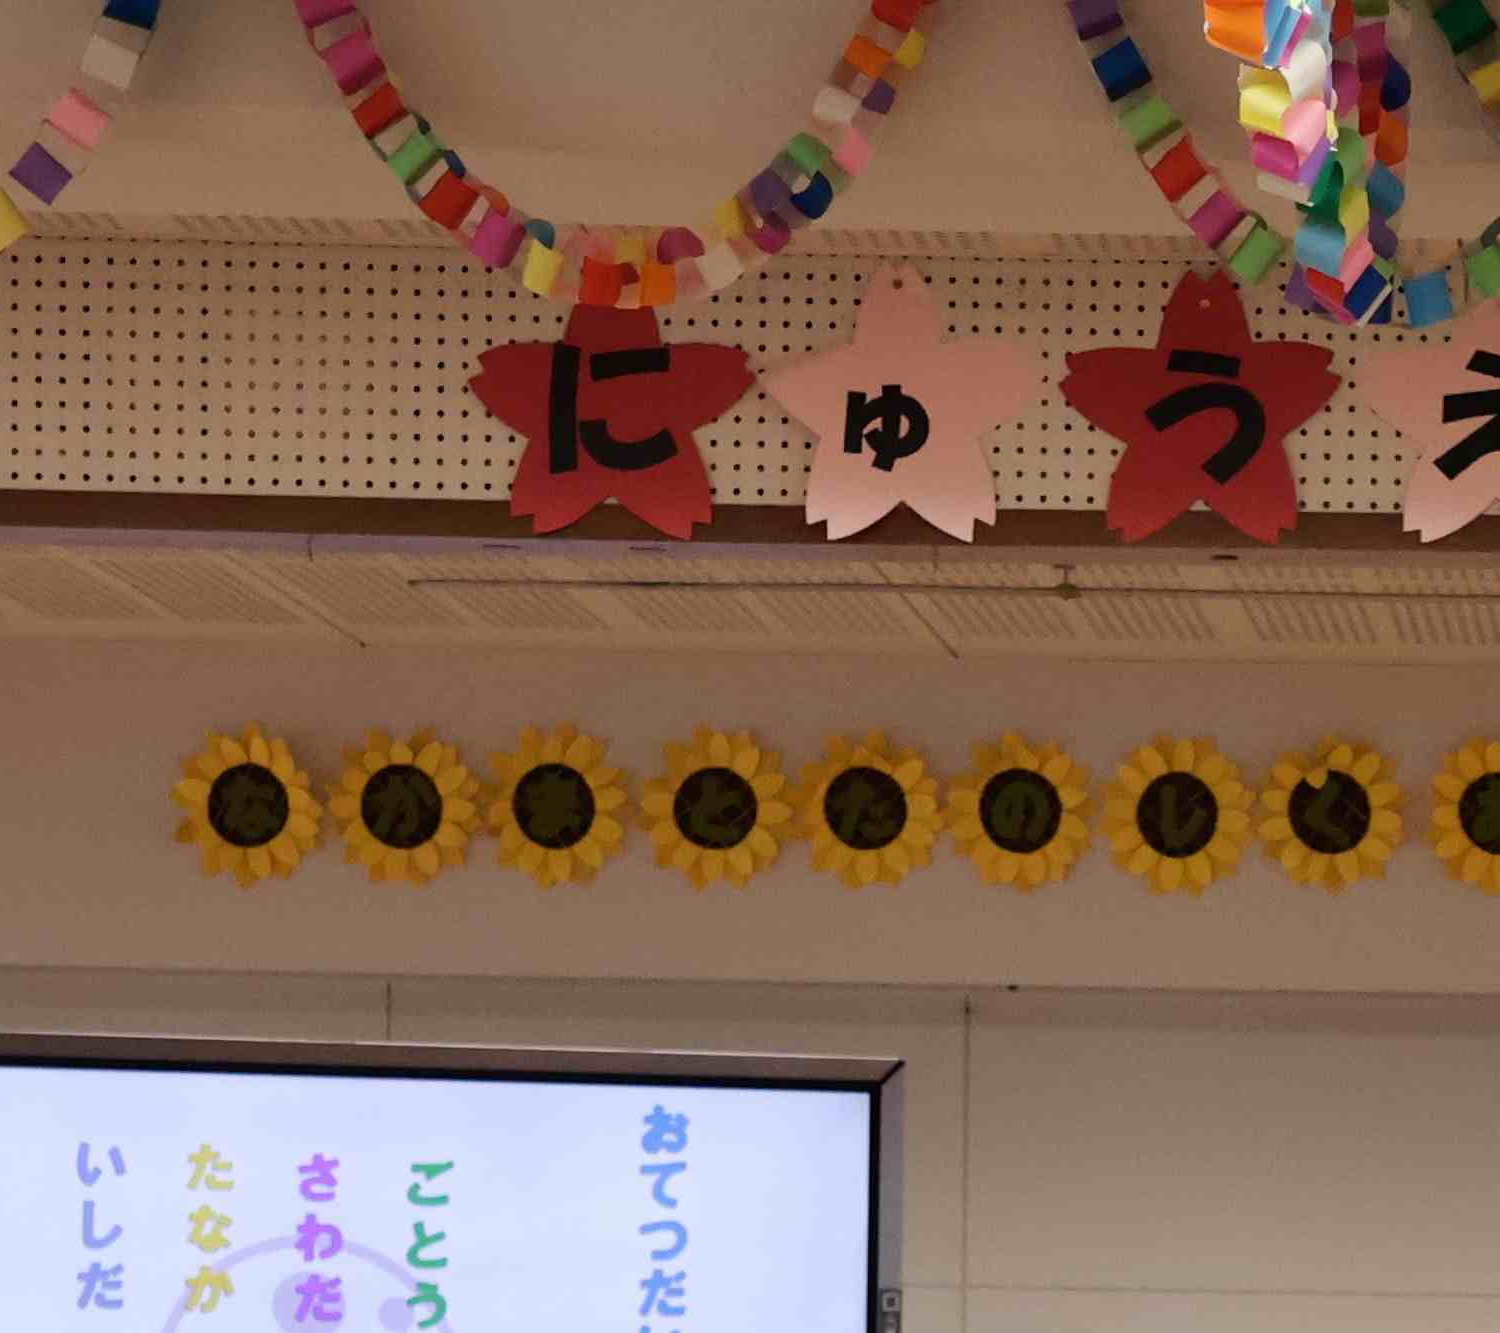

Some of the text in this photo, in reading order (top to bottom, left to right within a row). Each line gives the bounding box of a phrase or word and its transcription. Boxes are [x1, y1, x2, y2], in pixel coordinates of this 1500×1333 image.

[75, 1141, 127, 1311] いしだ
[186, 1142, 235, 1313] たなか
[292, 1152, 345, 1323] さわだ
[405, 1159, 455, 1330] ことう
